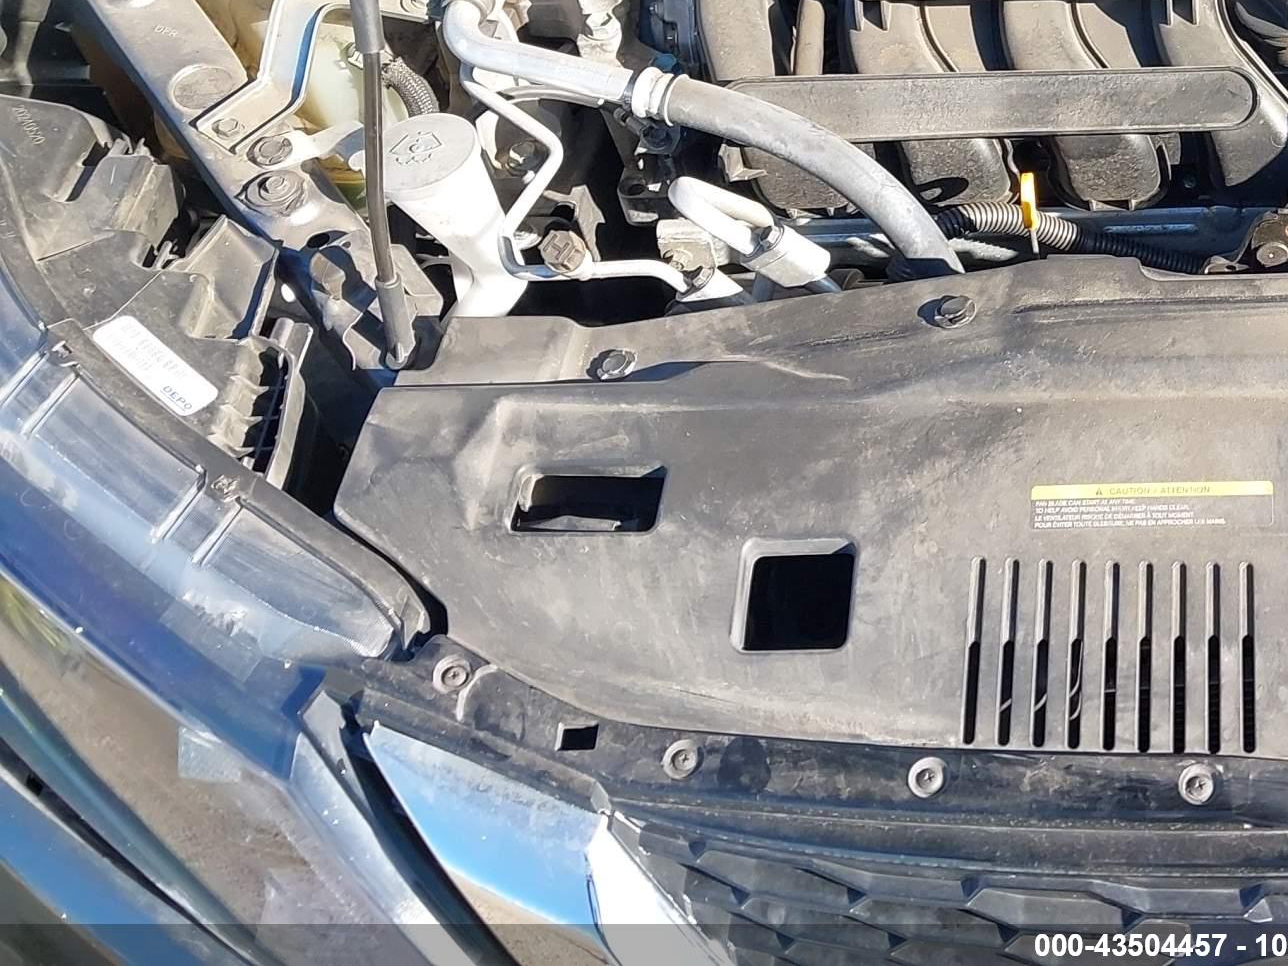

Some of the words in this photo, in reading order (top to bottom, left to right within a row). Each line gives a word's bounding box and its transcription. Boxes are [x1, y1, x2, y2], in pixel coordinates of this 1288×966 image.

[162, 385, 193, 410] DEPO
[1109, 487, 1150, 495] CAUTION
[1160, 486, 1210, 494] ATTENTION
